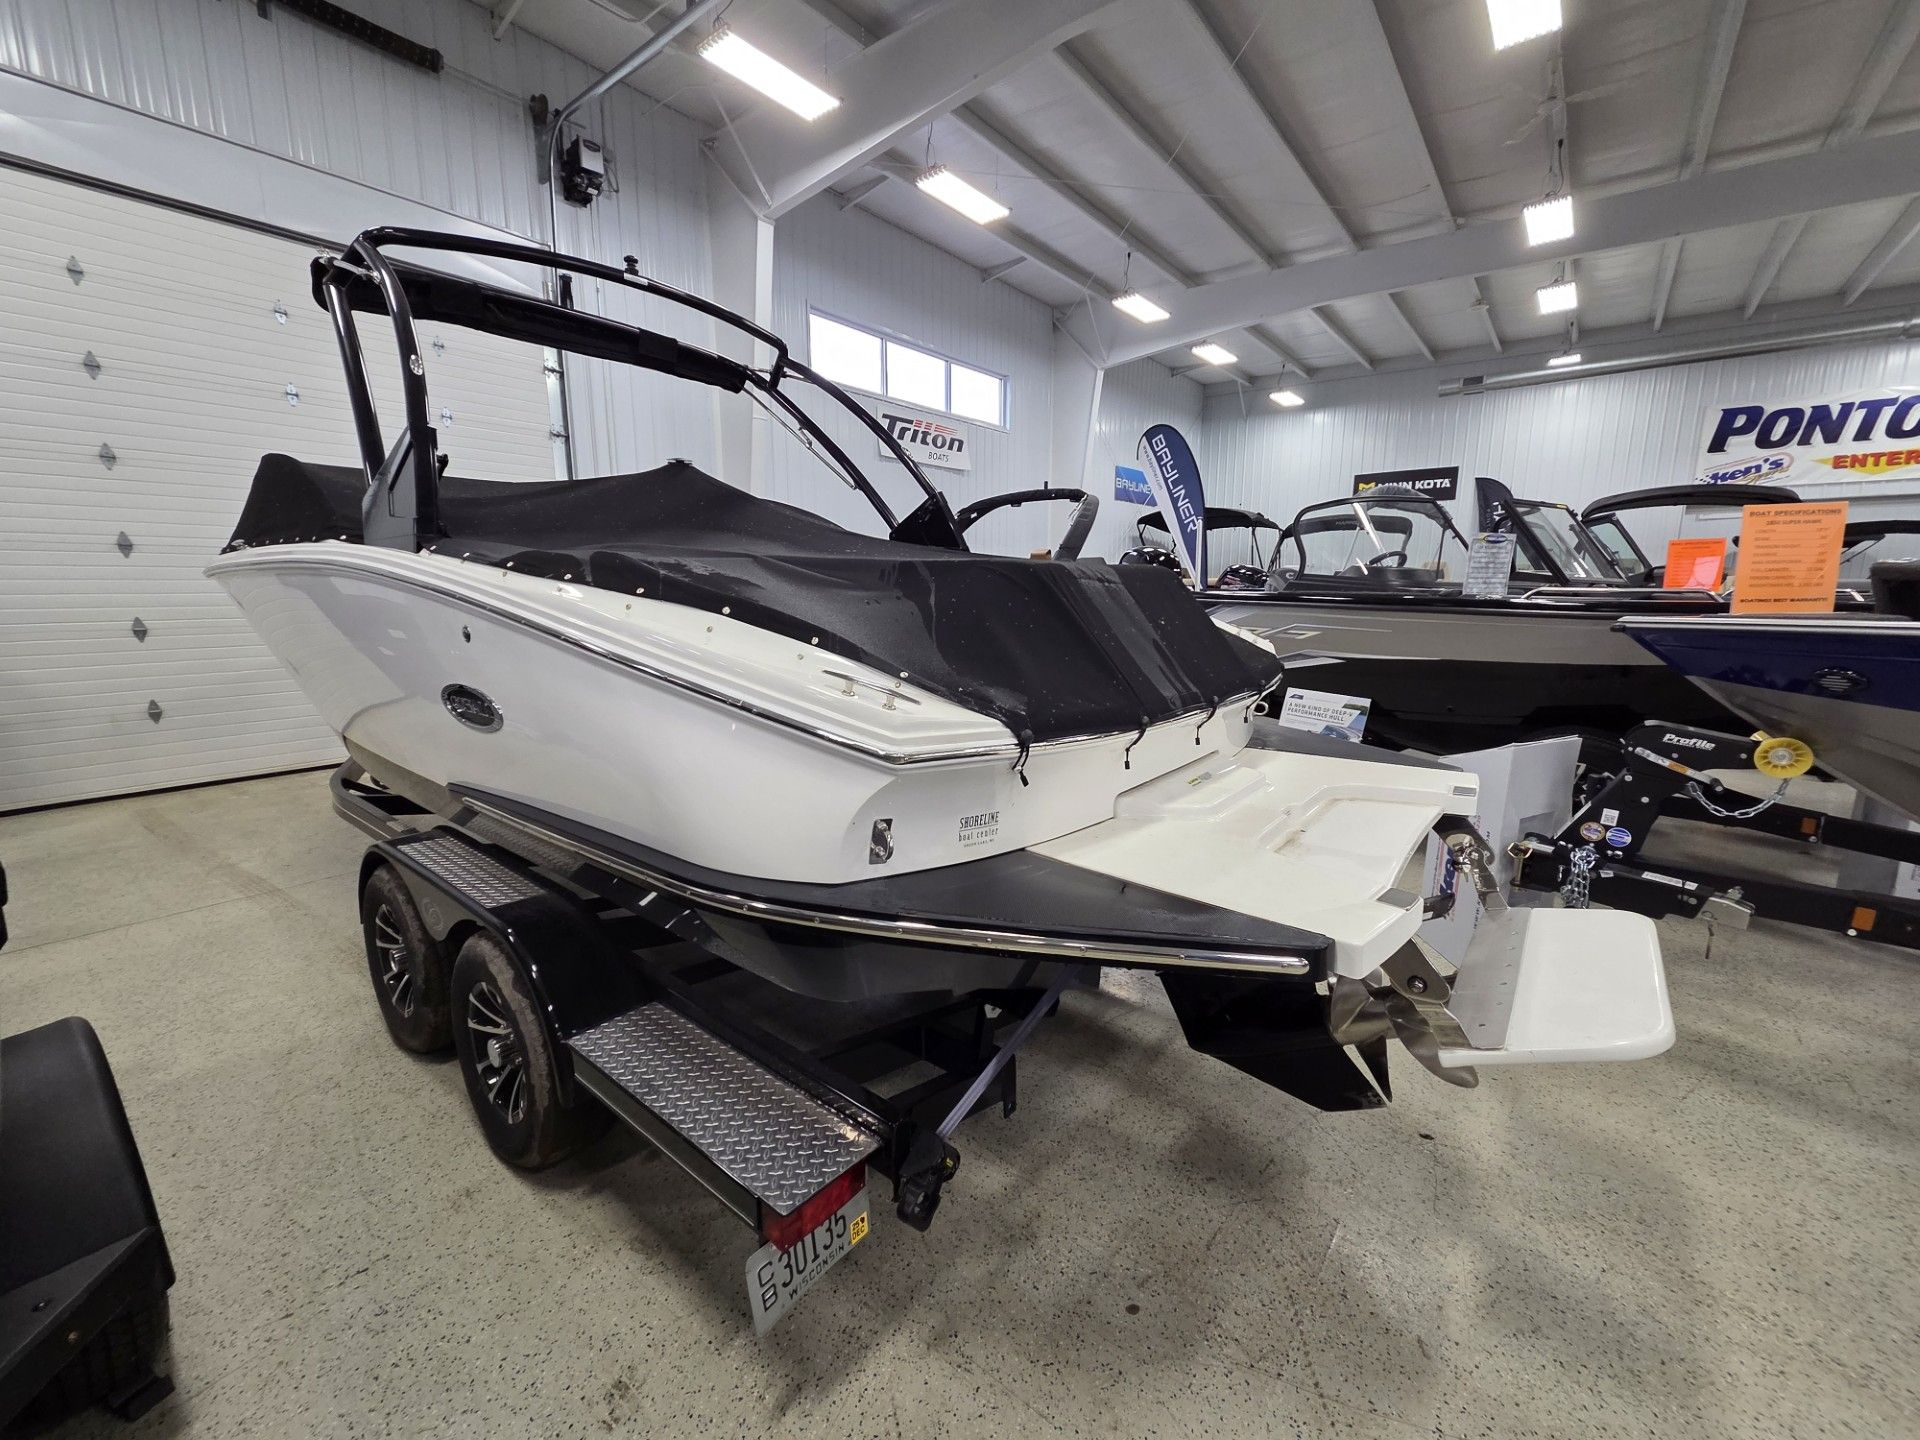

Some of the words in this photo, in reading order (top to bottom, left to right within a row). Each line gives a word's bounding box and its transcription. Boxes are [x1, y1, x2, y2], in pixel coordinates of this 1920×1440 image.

[882, 413, 964, 452] Triton
[1707, 394, 1920, 454] PONTO
[928, 451, 949, 463] BOATS
[1832, 450, 1920, 469] ENTER
[1116, 478, 1152, 493] BAYLINE
[1152, 434, 1198, 533] BAYLINER
[1415, 478, 1451, 490] KOTA
[1663, 733, 1716, 751] Profile
[960, 811, 999, 829] SHORELINE
[852, 1225, 865, 1240] DEC
